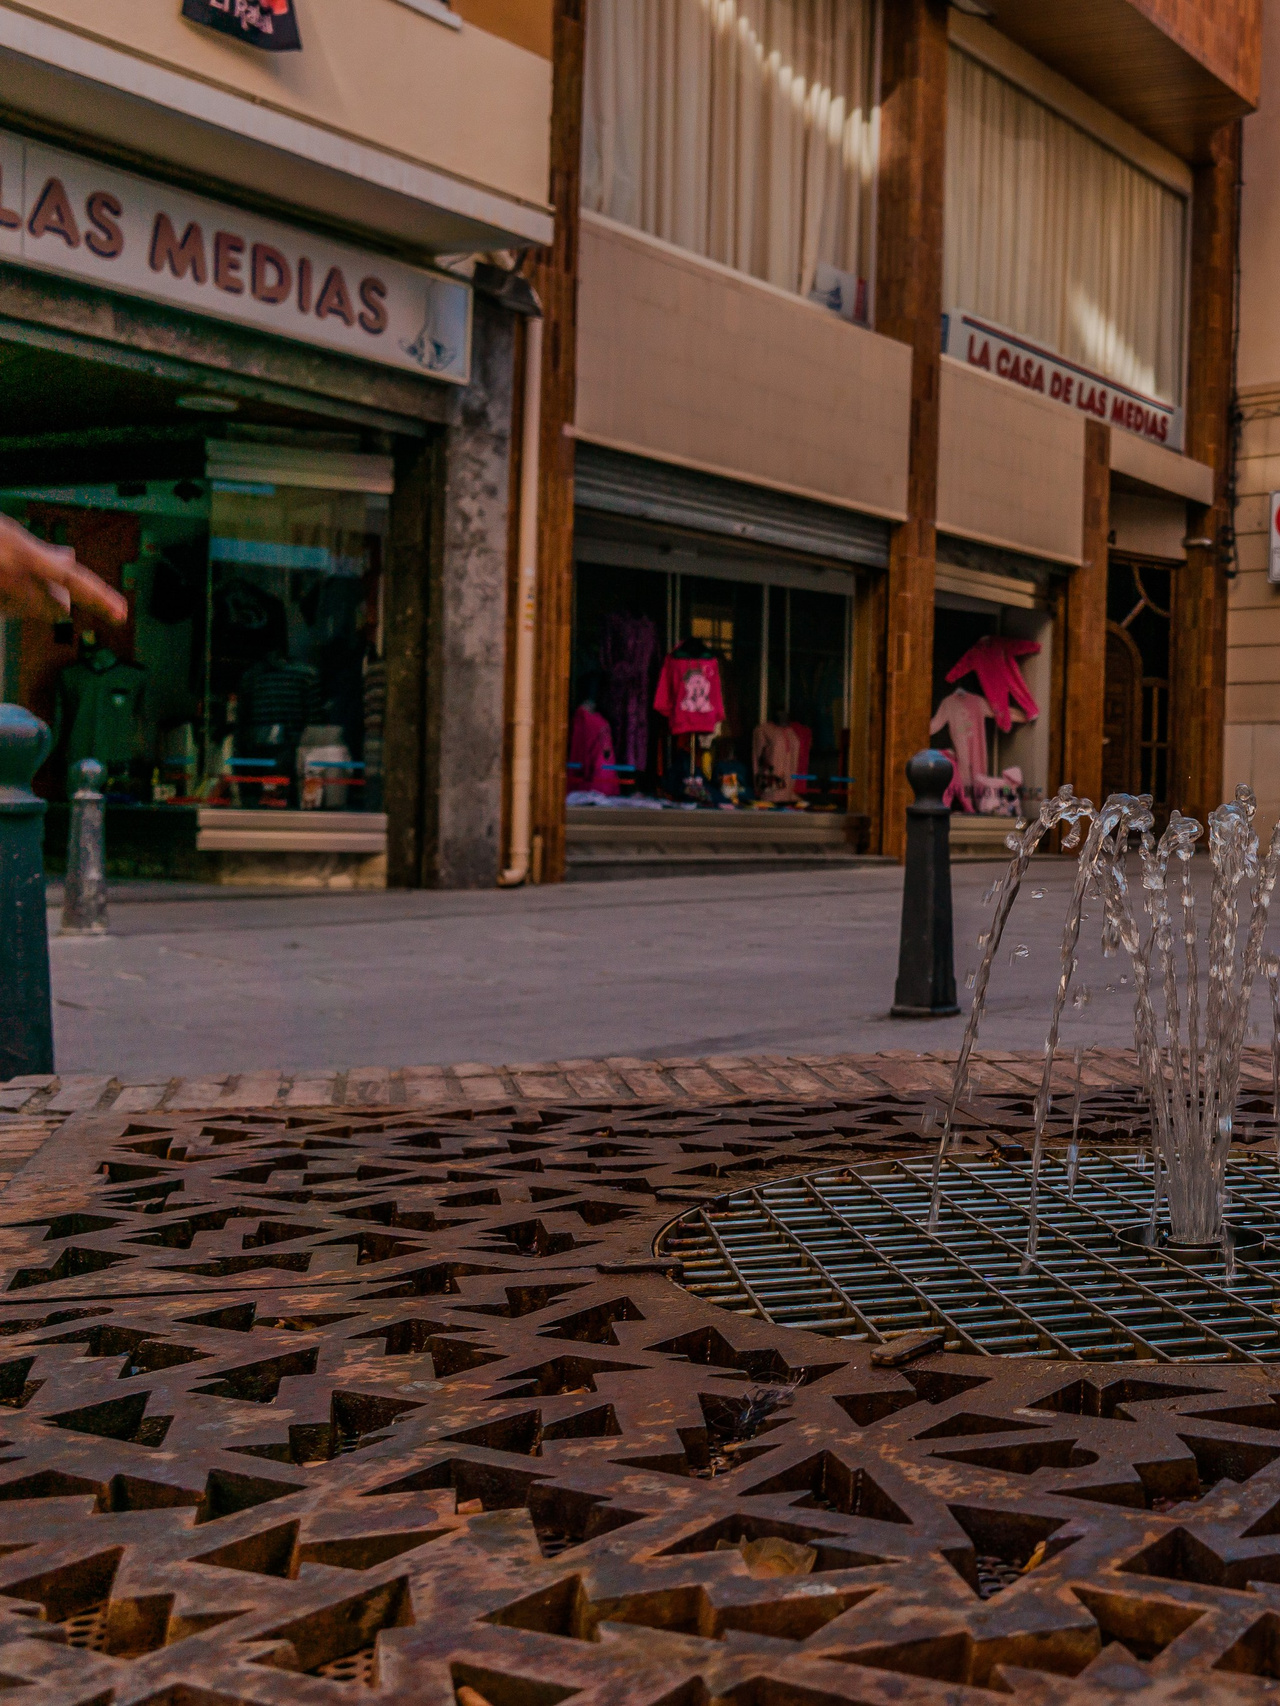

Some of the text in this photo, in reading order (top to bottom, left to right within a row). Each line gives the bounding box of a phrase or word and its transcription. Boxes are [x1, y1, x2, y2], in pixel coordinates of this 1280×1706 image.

[148, 211, 390, 336] MEDIAS
[967, 334, 1168, 442] LA CASA DE LAS MEDIAS
